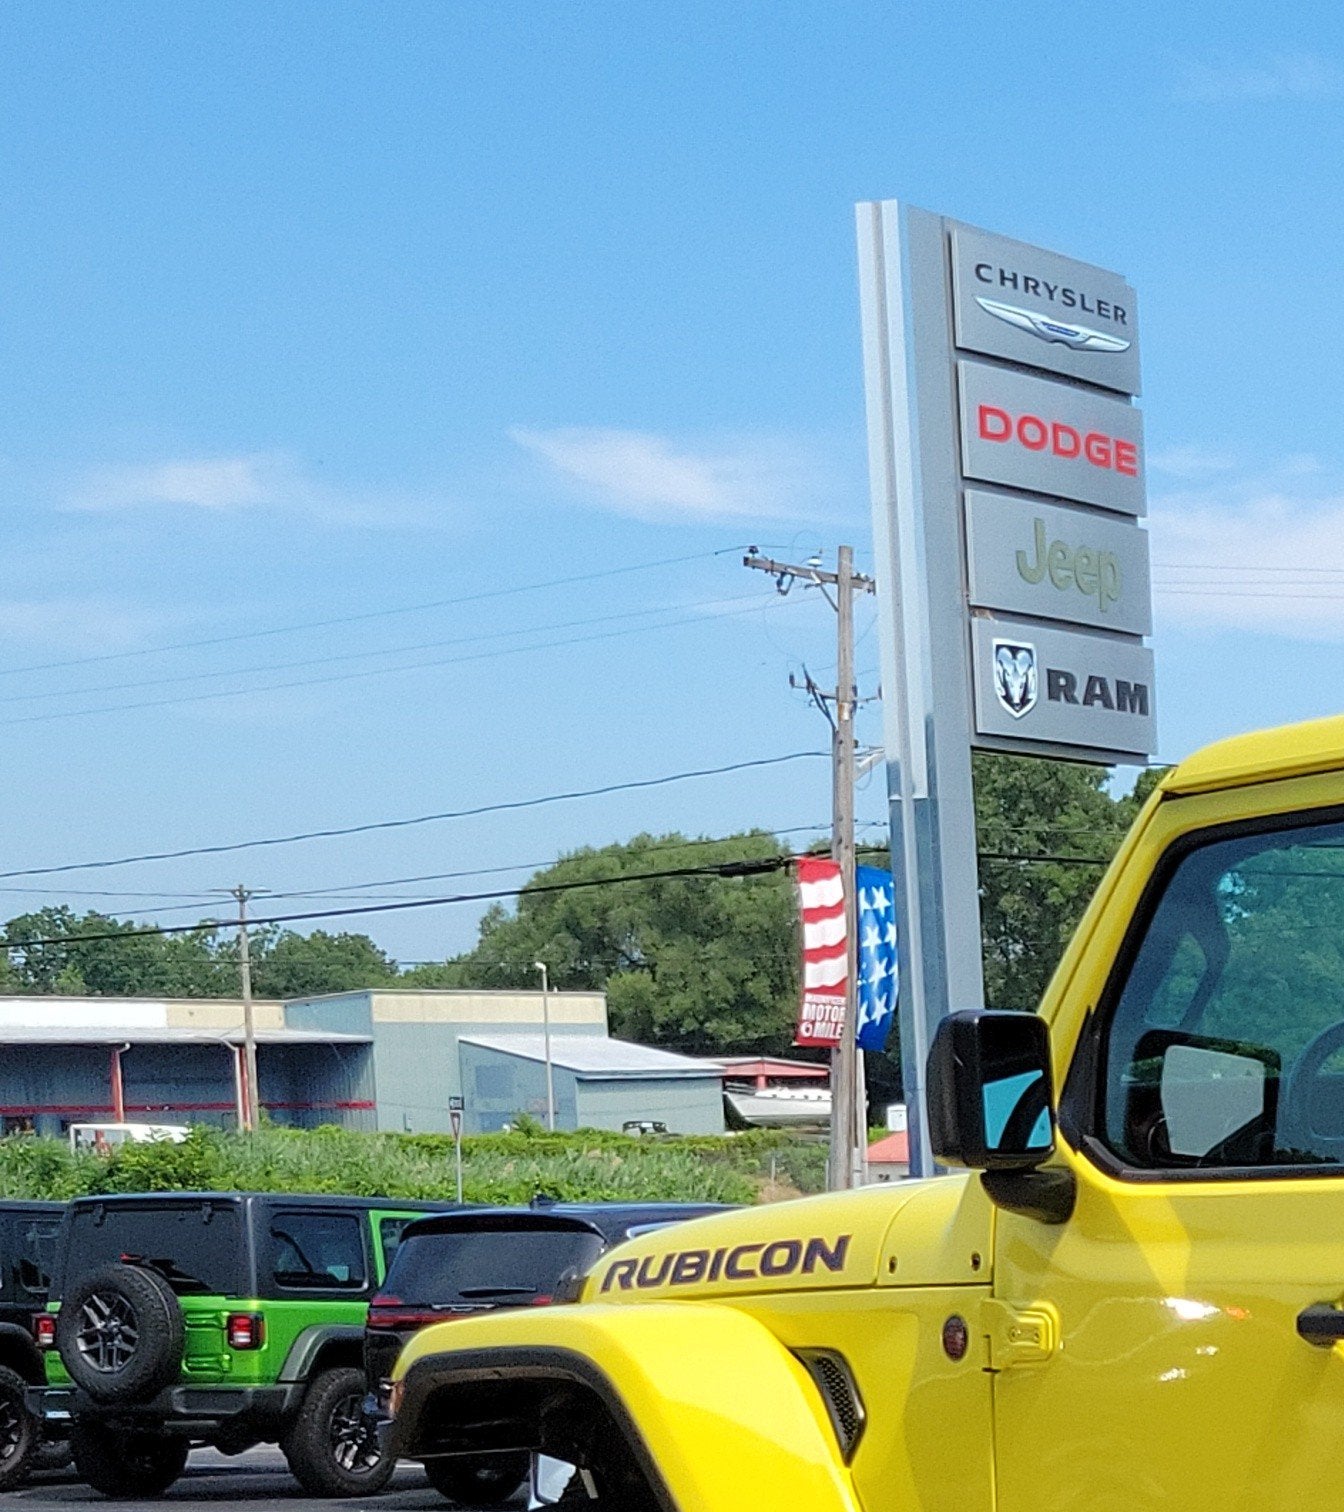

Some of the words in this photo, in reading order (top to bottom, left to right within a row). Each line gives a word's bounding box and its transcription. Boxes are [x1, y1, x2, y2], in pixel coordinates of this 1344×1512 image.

[975, 263, 1128, 325] CHRYSLER
[978, 404, 1138, 476] DODGE
[1016, 518, 1122, 612] Jeep
[1046, 669, 1149, 716] RAM
[601, 1235, 851, 1293] RUBICON
